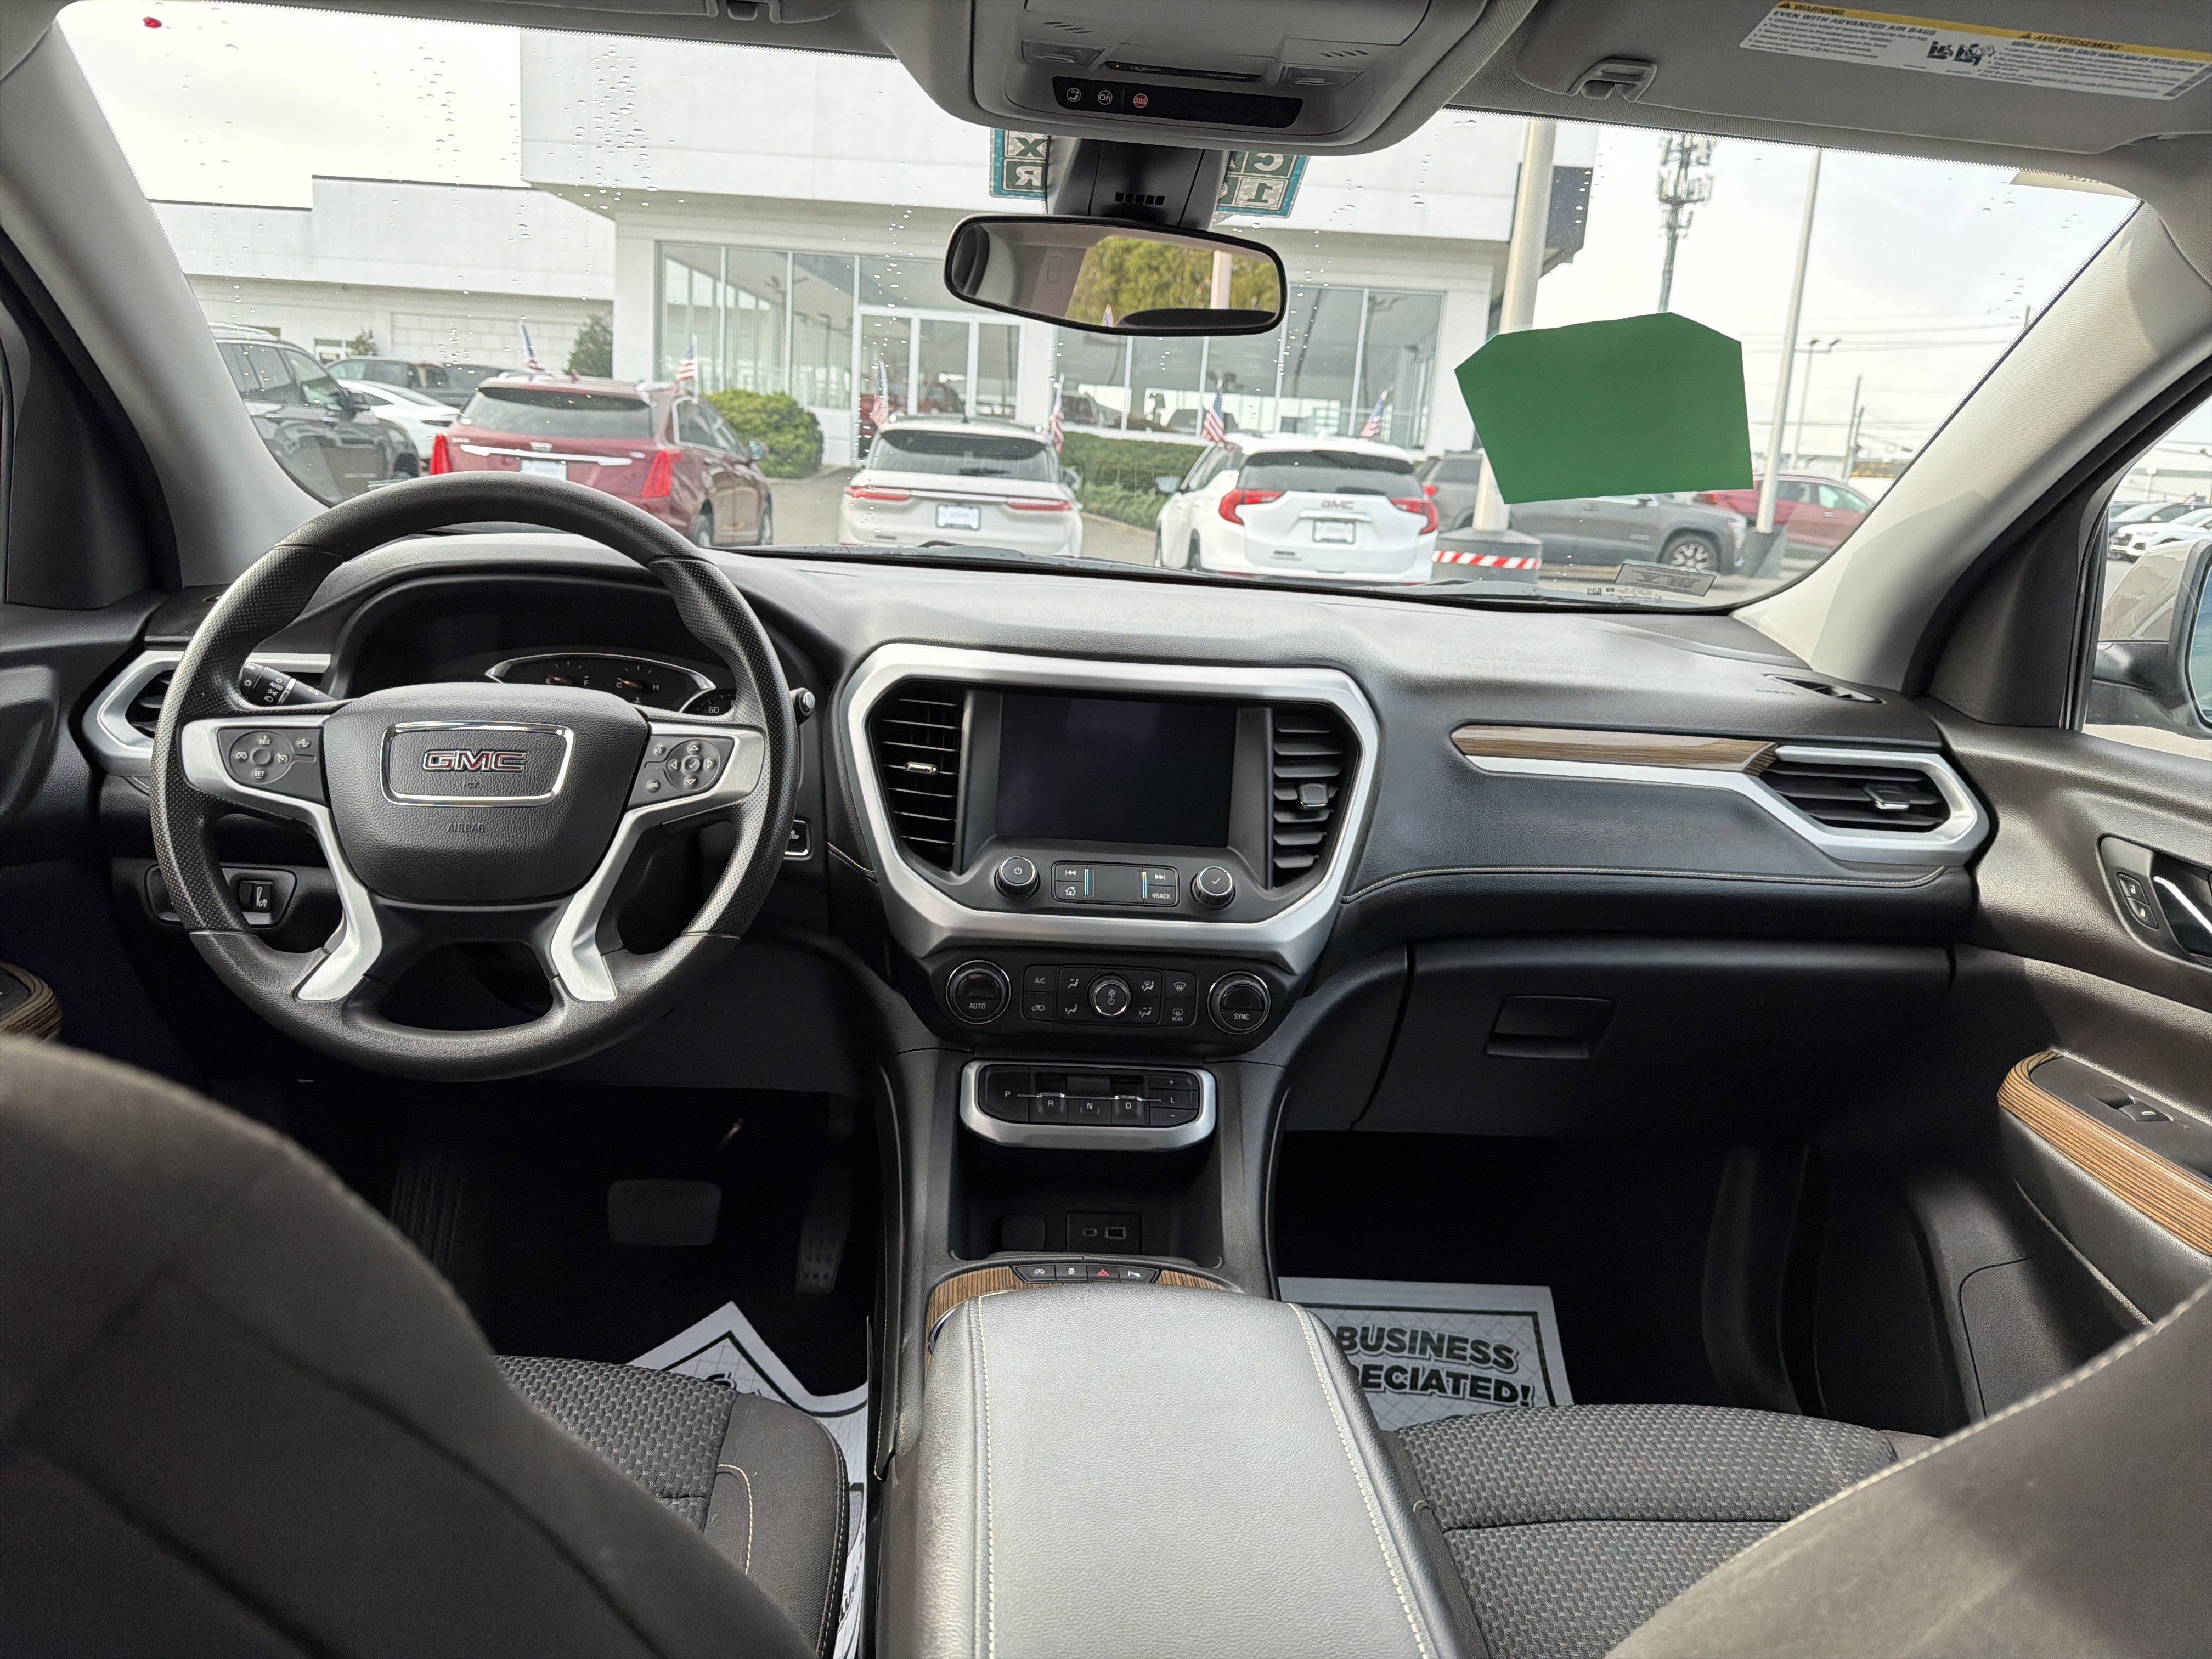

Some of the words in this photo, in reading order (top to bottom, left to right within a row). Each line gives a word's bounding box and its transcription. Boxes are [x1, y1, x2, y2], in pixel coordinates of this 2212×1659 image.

[1795, 4, 1845, 15] WARNING
[1830, 18, 1886, 29] ADVANCED
[269, 682, 283, 691] AUTO
[423, 749, 527, 773] GMC
[447, 822, 486, 833] AIRBAG
[1336, 1325, 1516, 1370] BUSINESS
[1353, 1363, 1532, 1407] ECIATED!
